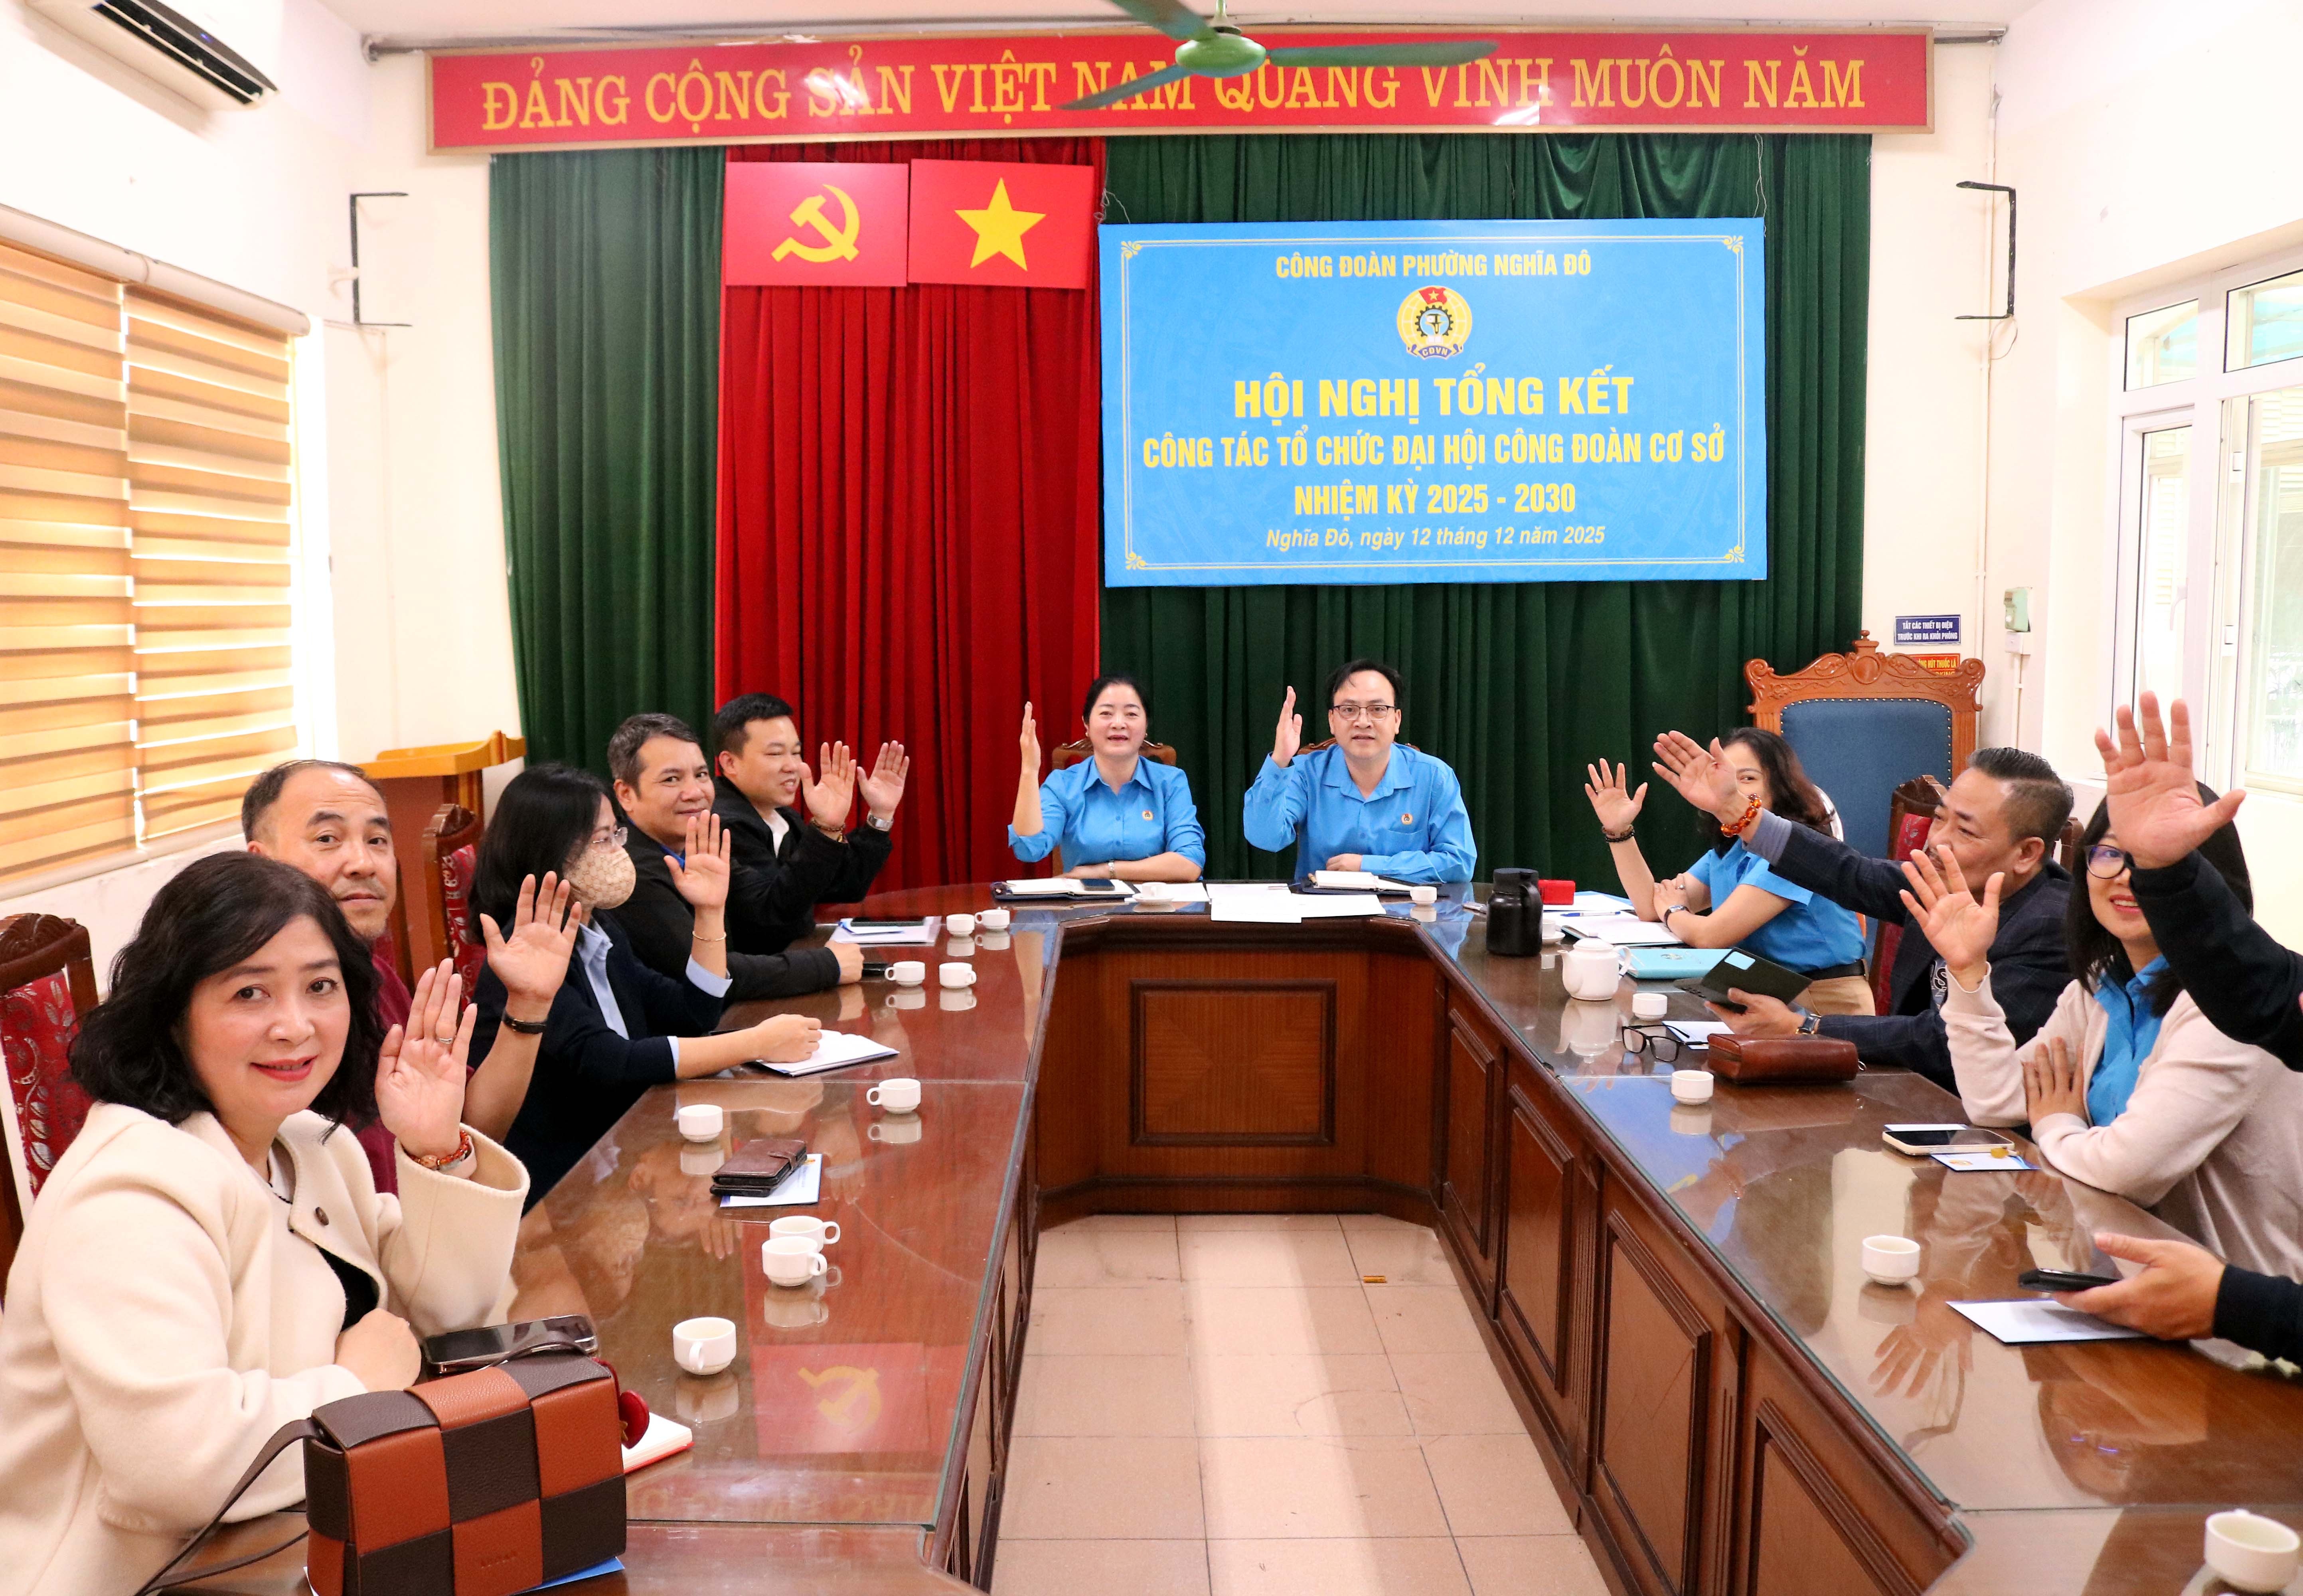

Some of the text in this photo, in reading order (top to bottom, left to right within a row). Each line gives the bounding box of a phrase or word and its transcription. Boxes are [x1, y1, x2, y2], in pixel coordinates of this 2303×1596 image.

[481, 43, 1865, 133] ĐẢNG CỘNG SẢN VIỆT NAM QUANG VINH MUÔN NĂM
[1276, 253, 1590, 277] CÔNG ĐOÀN PHƯỜNG NGHĨA ĐÔ
[1235, 363, 1633, 426] HỘI NGHỊ TỔNG KẾT
[1144, 423, 1725, 471] CÔNG TÁC TỔ CHỨC ĐẠI HỘI CÔNG ĐOÀN CƠ SỞ
[1295, 480, 1378, 521] NHIỆM
[1387, 479, 1418, 514] KỲ
[1428, 484, 1488, 513] 2025
[1515, 484, 1575, 512] 2030
[1266, 526, 1605, 552] Nghĩa Đô, ngày 12 tháng 12 năm 2025
[1922, 620, 1935, 629] THIẾT
[1942, 620, 1953, 630] ĐIỆN
